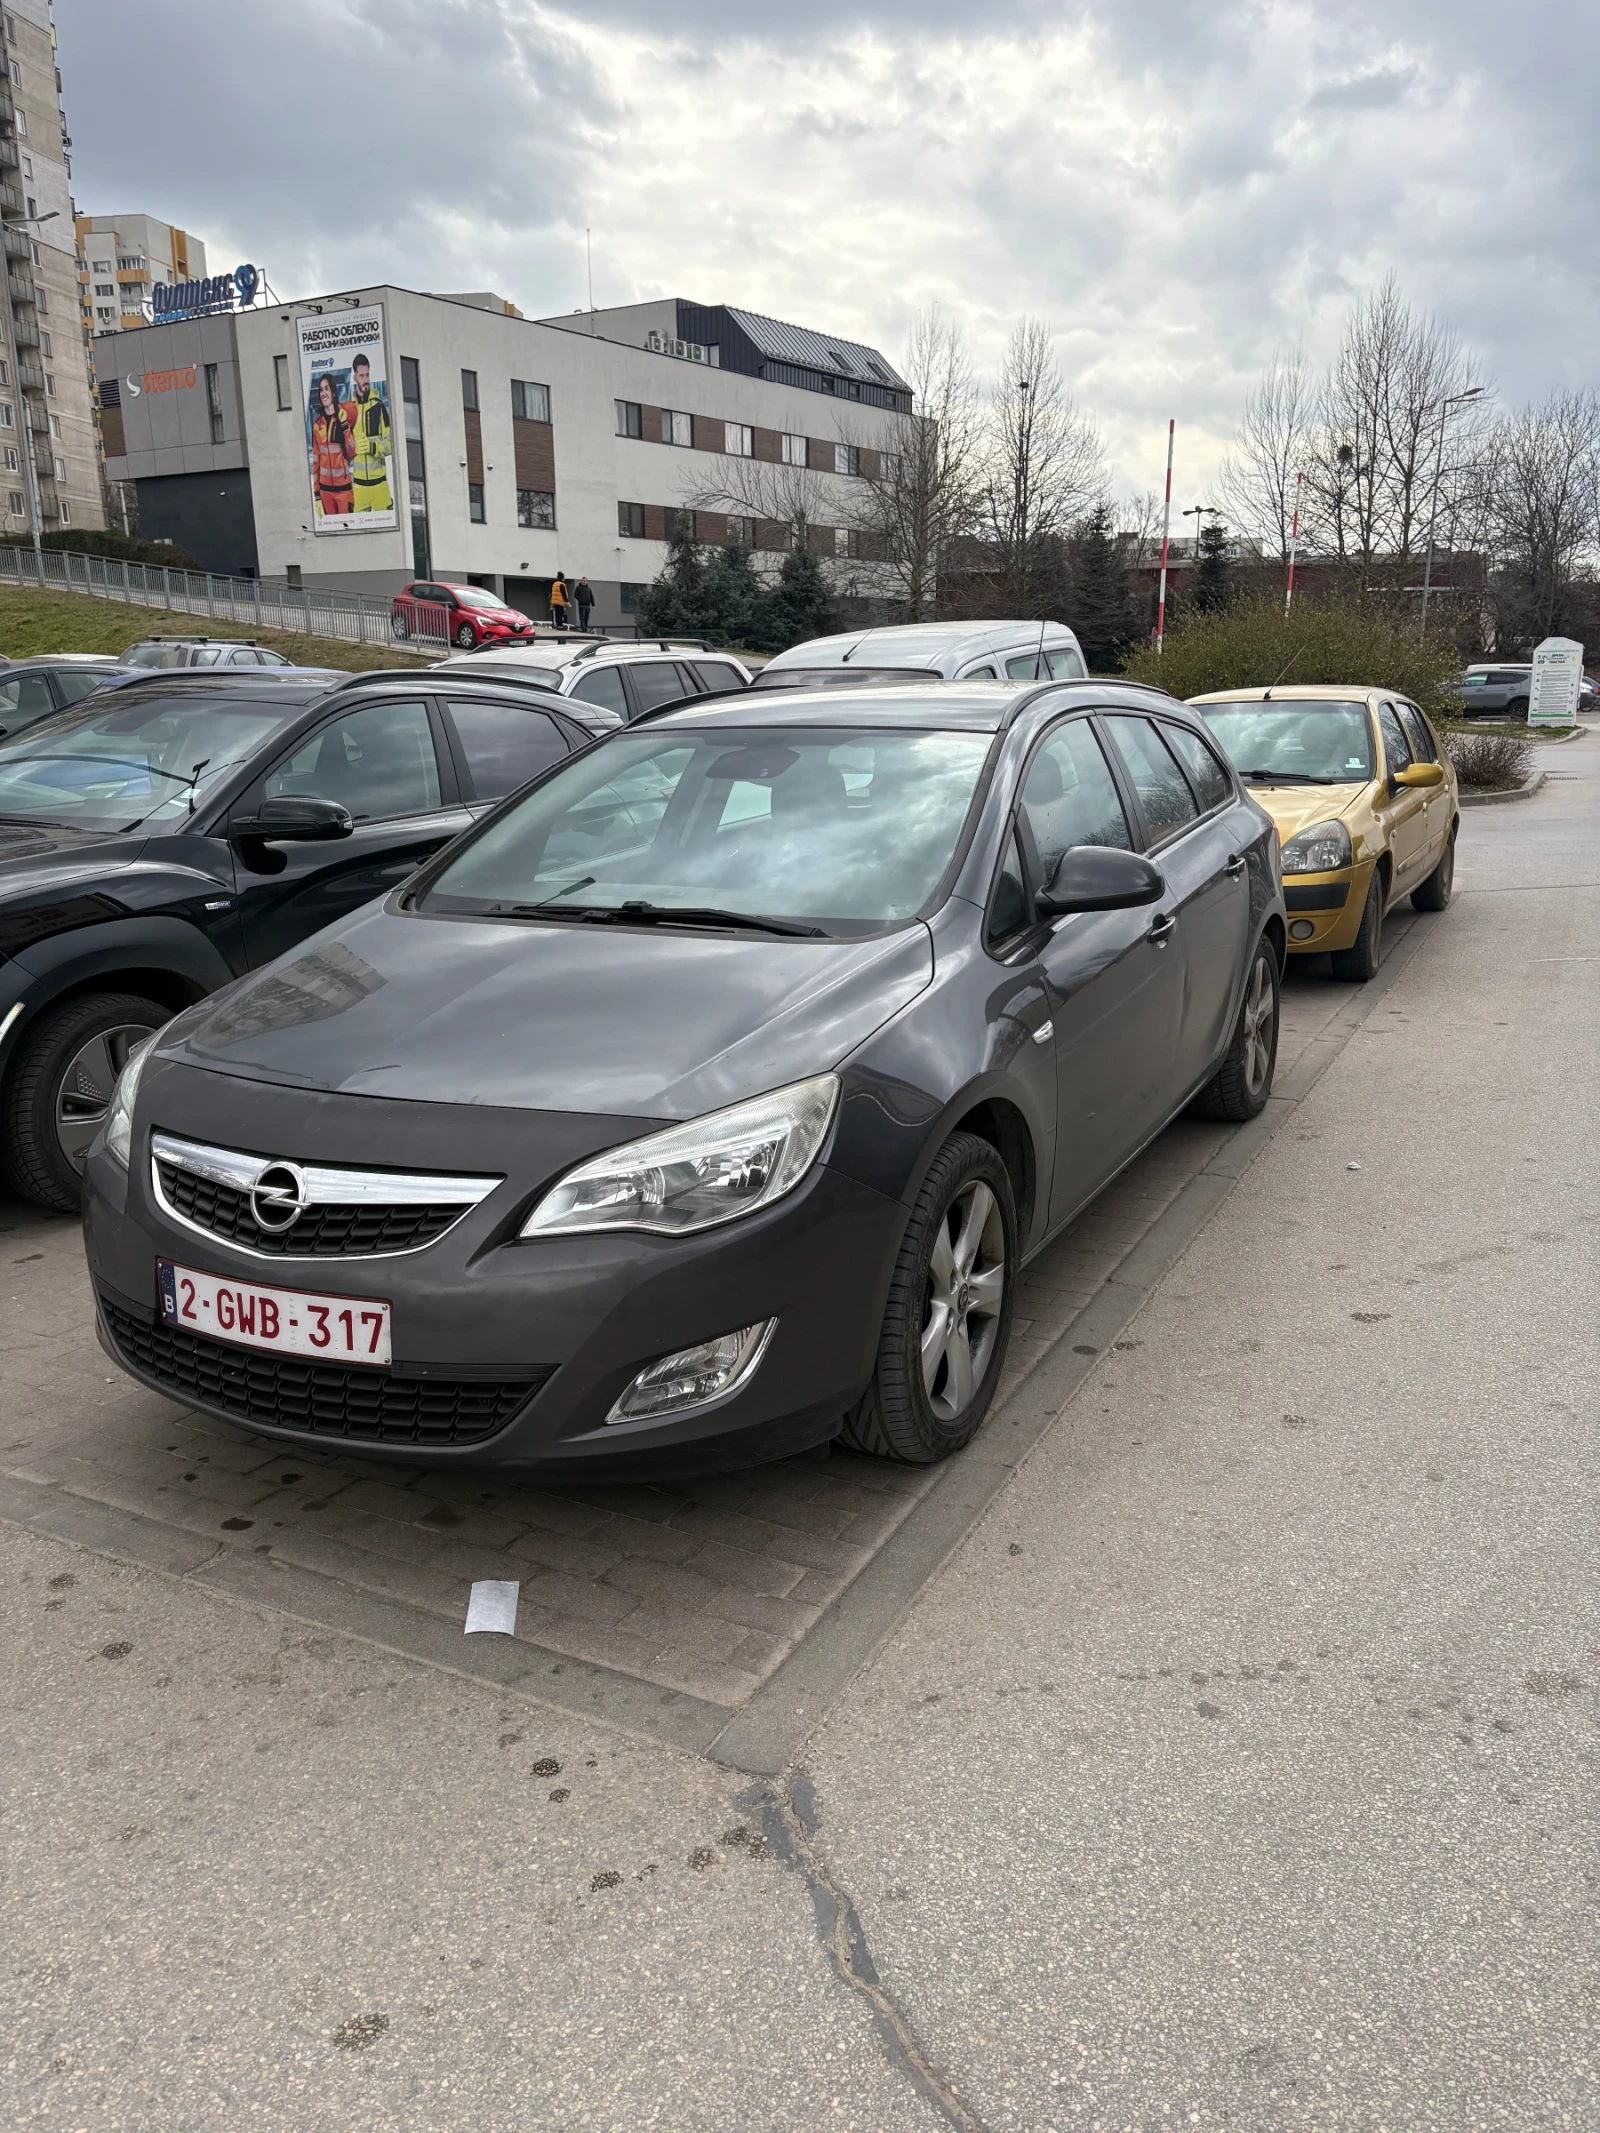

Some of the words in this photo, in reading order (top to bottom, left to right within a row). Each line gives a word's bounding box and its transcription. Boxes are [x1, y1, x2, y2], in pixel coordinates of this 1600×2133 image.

[302, 327, 340, 343] РАБОТНО
[341, 320, 379, 336] ОБЛЕКЛО
[303, 338, 340, 352] ПРЕДПАЗНИ
[339, 332, 380, 347] ЕКИПИРОВКИ
[142, 368, 196, 393] stenso
[164, 1294, 174, 1313] B
[180, 1278, 383, 1354] 2-GWB-317
